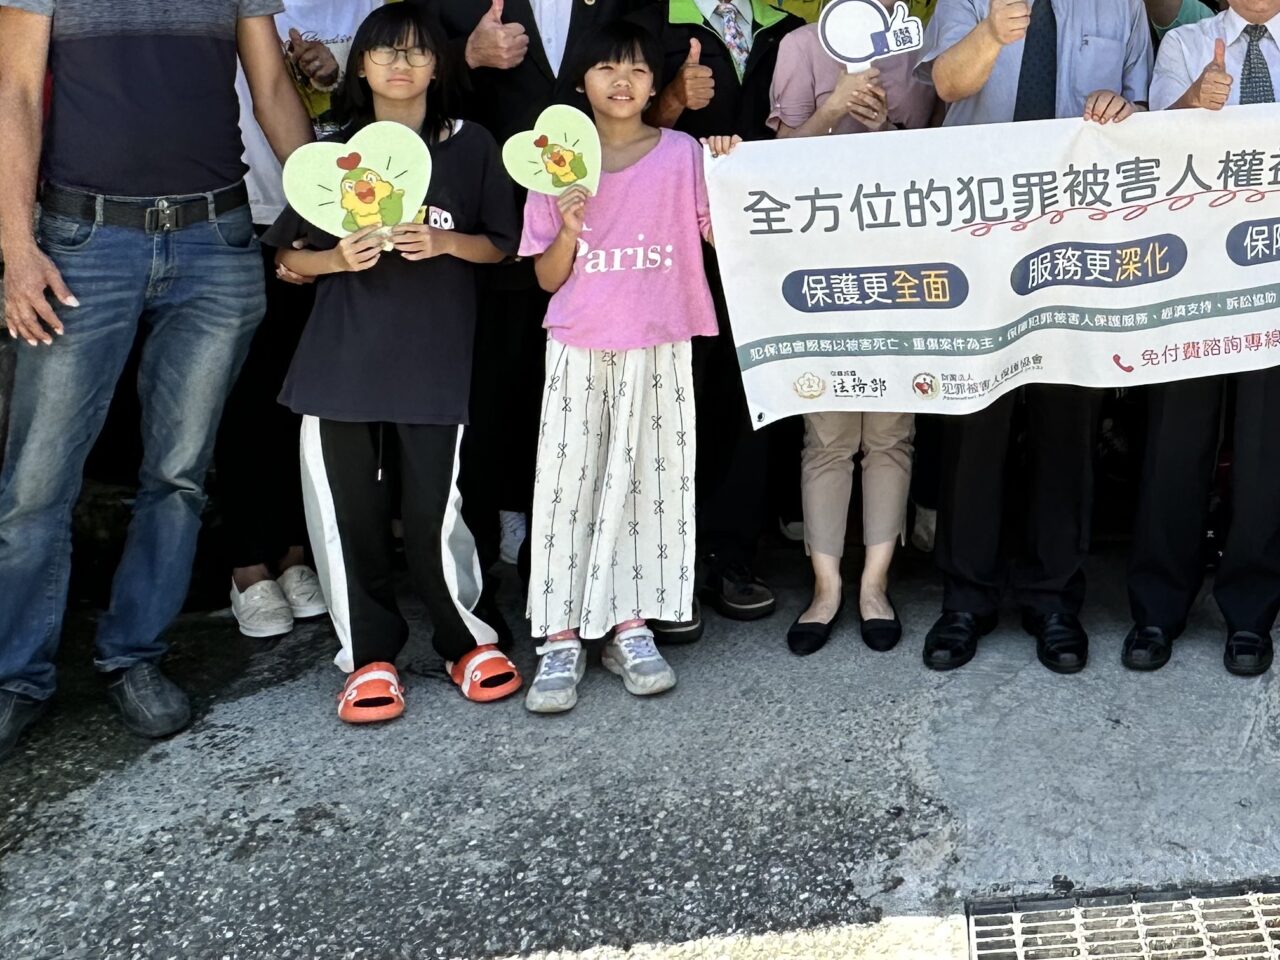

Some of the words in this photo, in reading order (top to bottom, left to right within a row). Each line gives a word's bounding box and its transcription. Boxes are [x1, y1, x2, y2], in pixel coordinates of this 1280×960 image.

[1027, 241, 1171, 290] 服務更深化
[801, 269, 952, 308] 保護更全面
